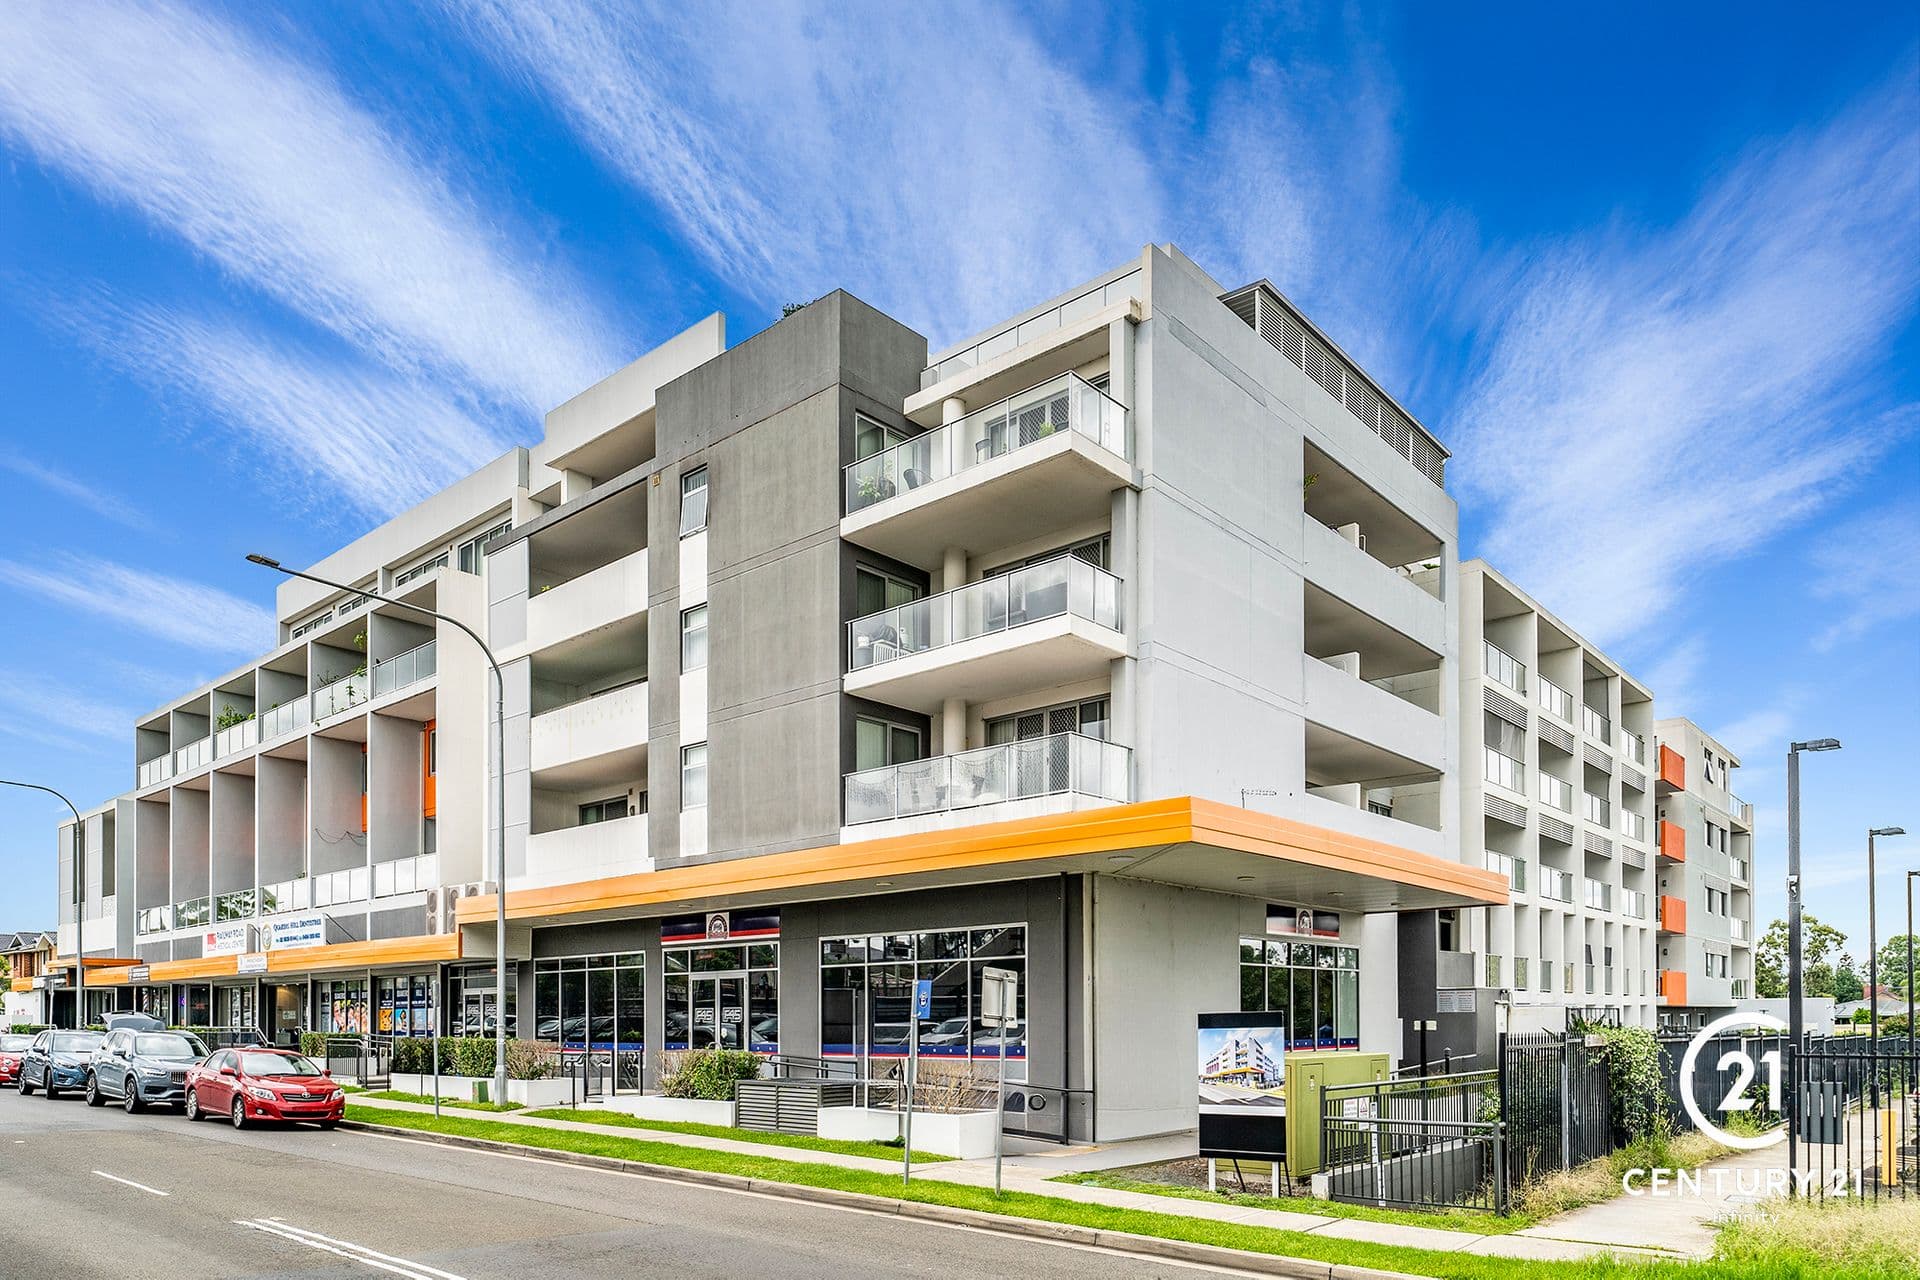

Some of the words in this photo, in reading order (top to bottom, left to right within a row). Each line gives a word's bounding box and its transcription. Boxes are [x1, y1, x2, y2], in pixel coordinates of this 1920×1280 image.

[217, 931, 232, 939] RAILWAY
[233, 928, 244, 937] ROAD
[695, 1008, 714, 1023] F45
[722, 1007, 742, 1022] F45
